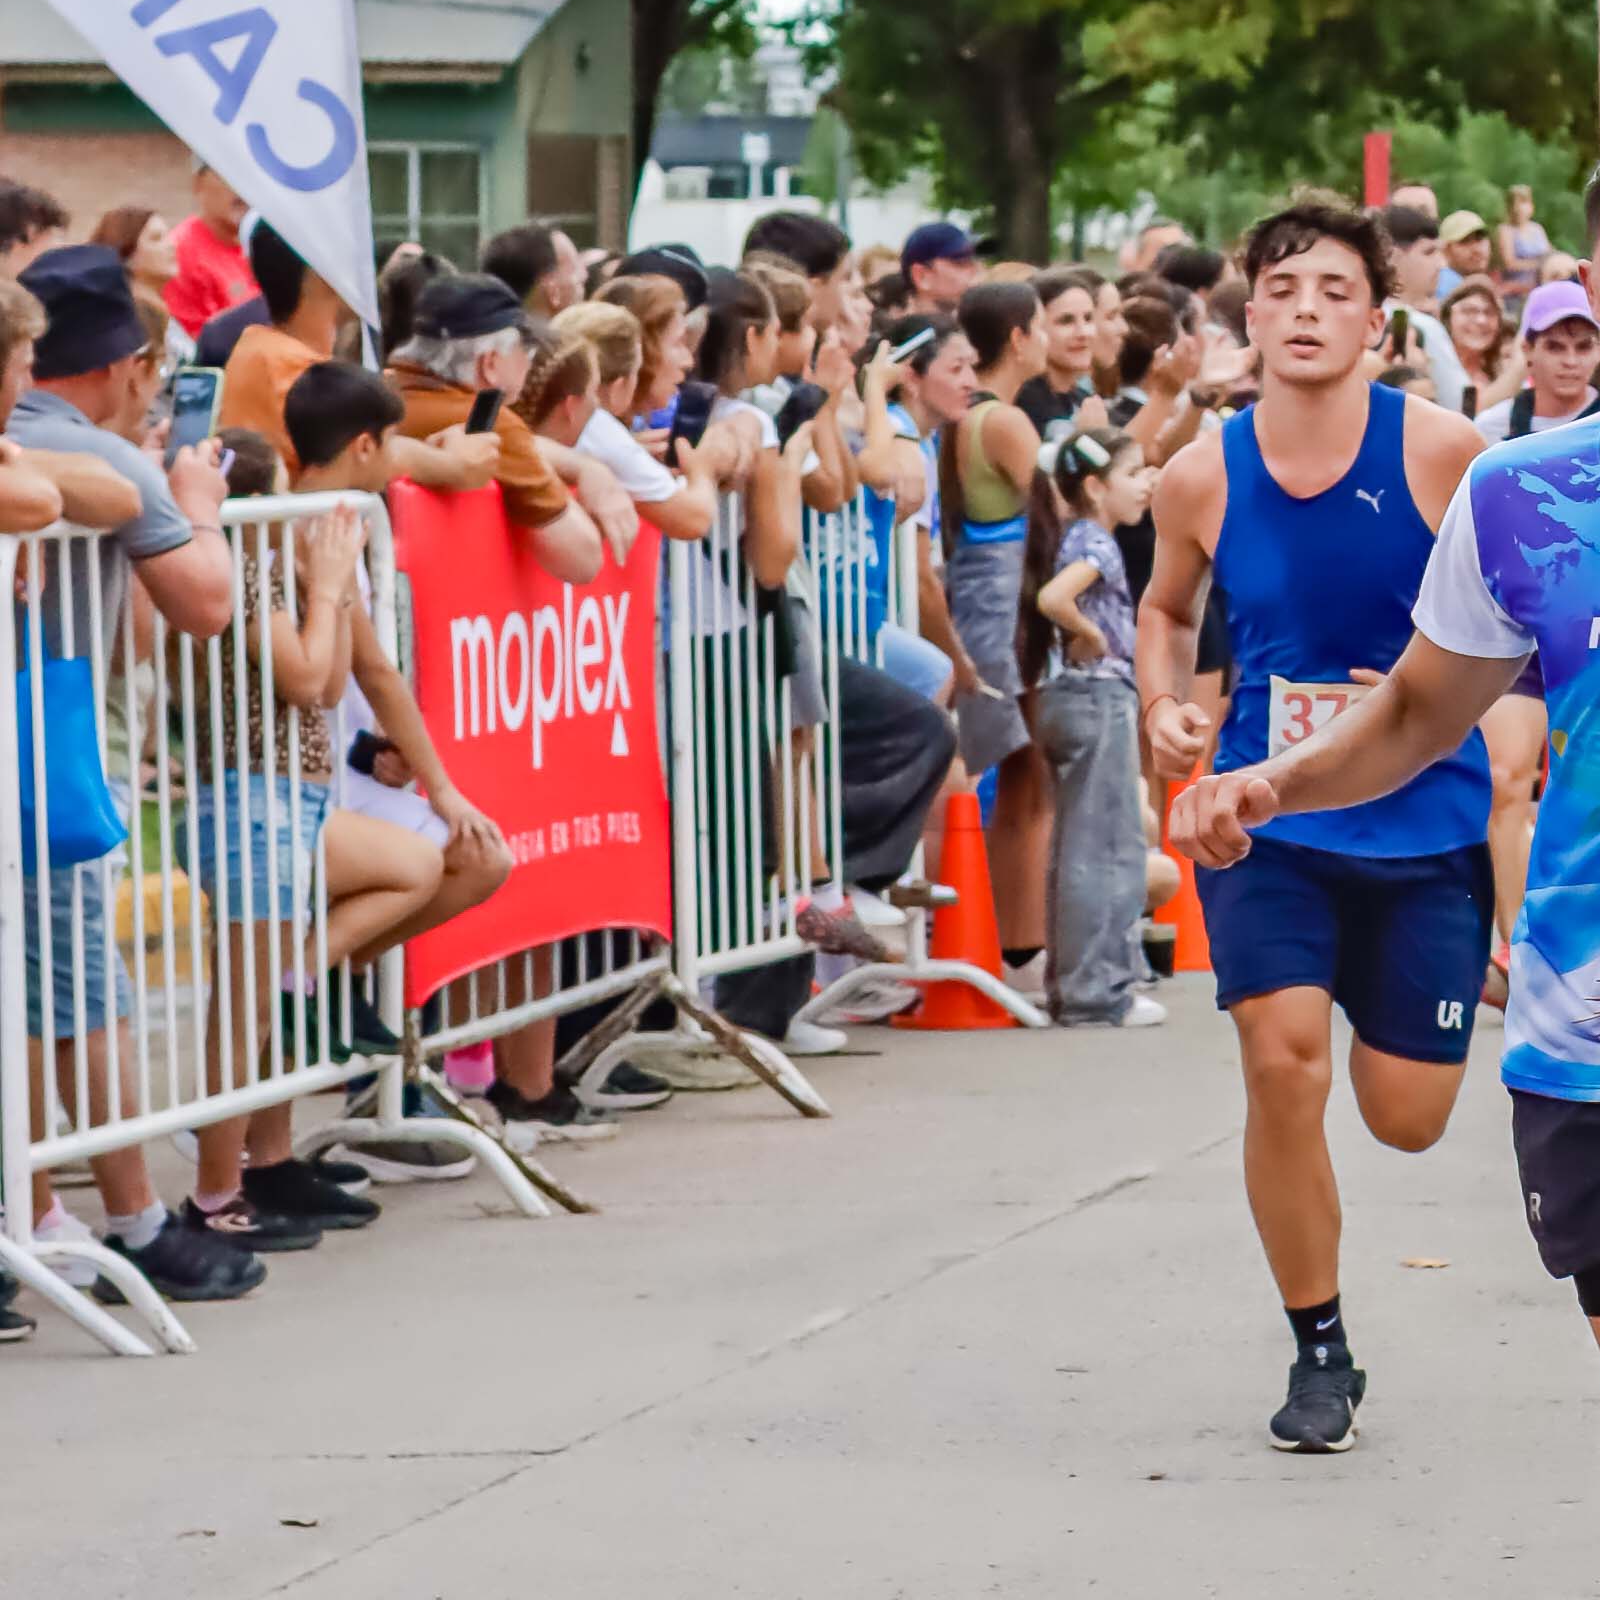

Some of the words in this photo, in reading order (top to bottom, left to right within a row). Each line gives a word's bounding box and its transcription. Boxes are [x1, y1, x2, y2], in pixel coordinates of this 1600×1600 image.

[450, 582, 633, 770] moplex
[1282, 692, 1358, 744] 37
[1437, 1000, 1464, 1029] UR
